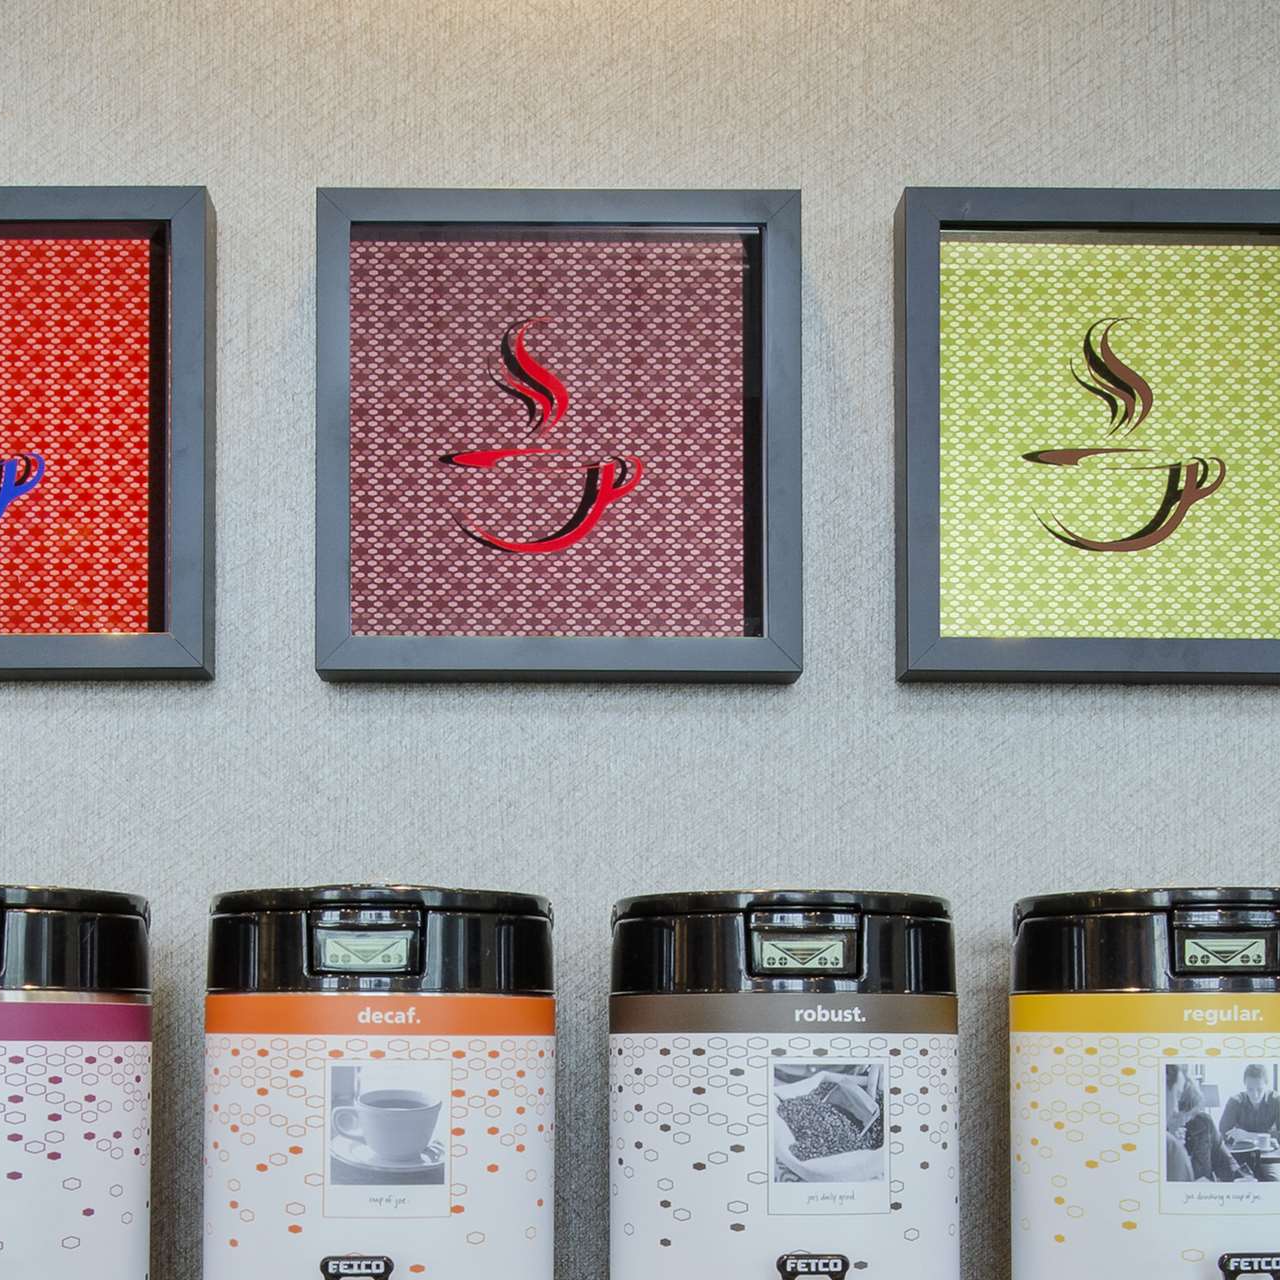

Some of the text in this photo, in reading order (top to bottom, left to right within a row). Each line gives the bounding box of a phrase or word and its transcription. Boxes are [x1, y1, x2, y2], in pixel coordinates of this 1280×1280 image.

[357, 1006, 421, 1024] decaf.
[794, 1004, 867, 1022] robust.
[1183, 1004, 1264, 1026] regular.
[328, 1260, 385, 1274] FETCO
[786, 1259, 842, 1272] FETCO
